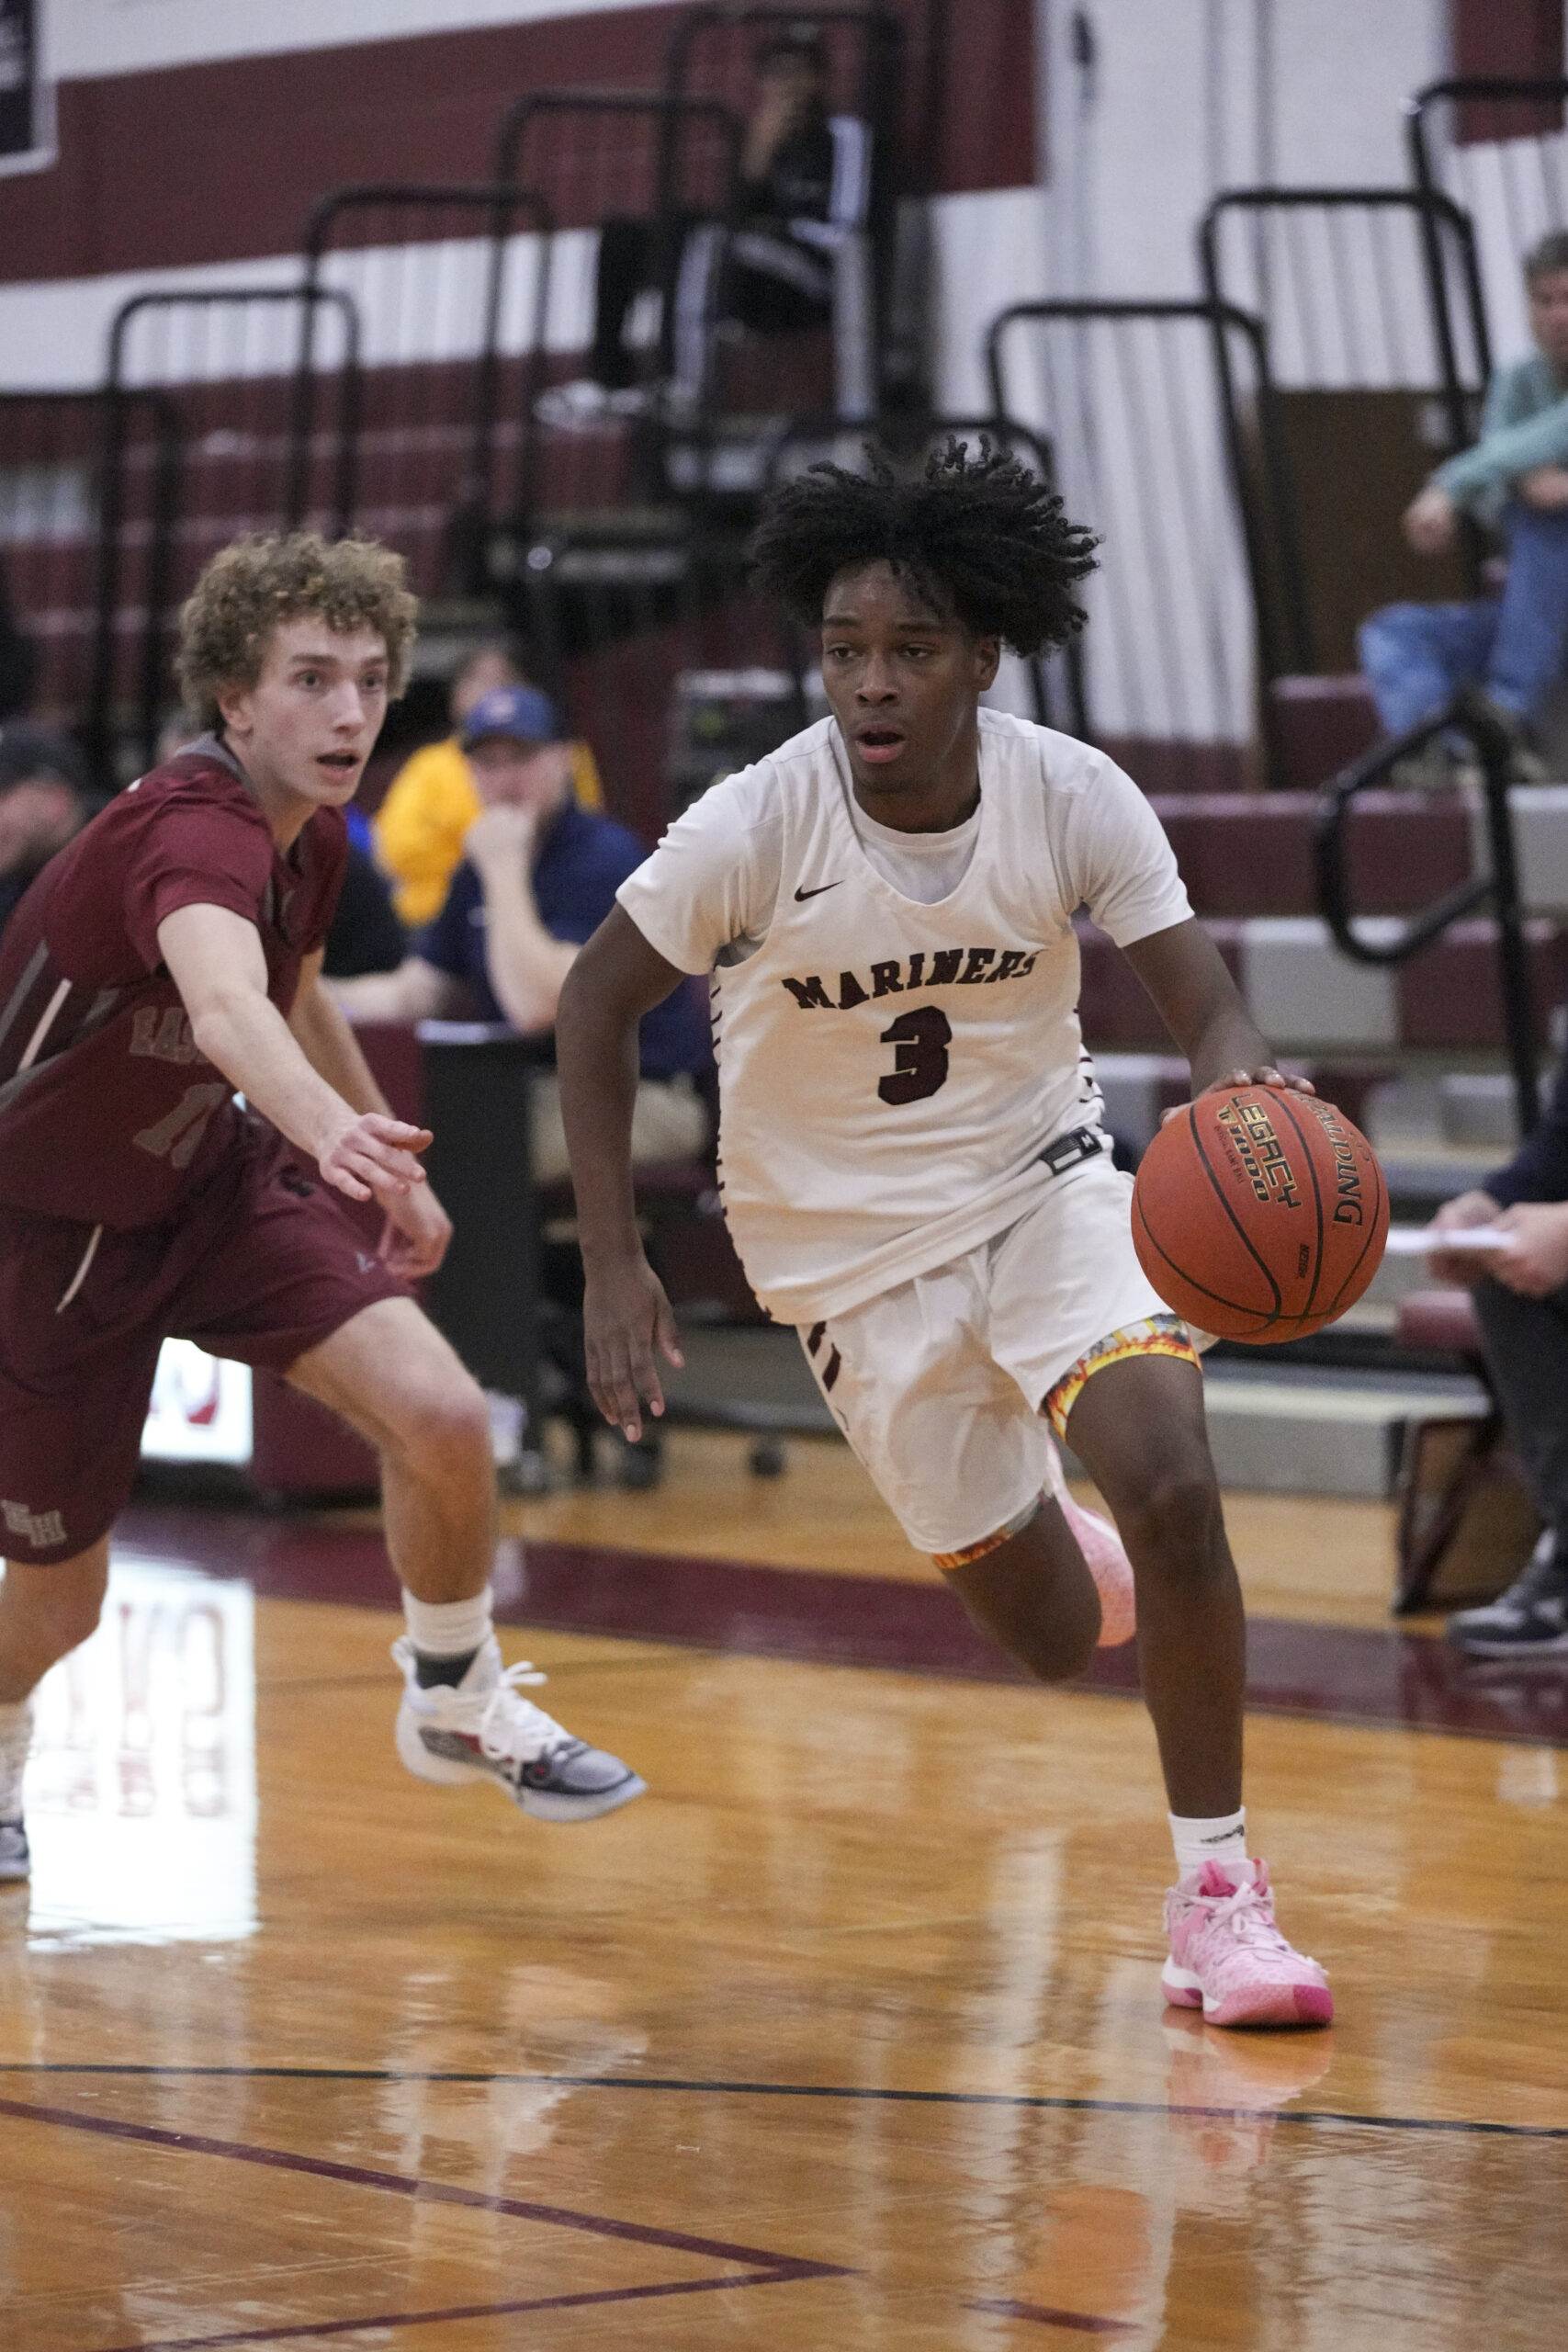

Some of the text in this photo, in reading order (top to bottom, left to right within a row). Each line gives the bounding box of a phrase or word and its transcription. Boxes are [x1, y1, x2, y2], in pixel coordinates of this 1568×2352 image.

[782, 948, 1043, 1010] MARINERS
[878, 1005, 952, 1105] 3
[1227, 1125, 1270, 1202] 1000
[1231, 1092, 1303, 1209] LEGACY
